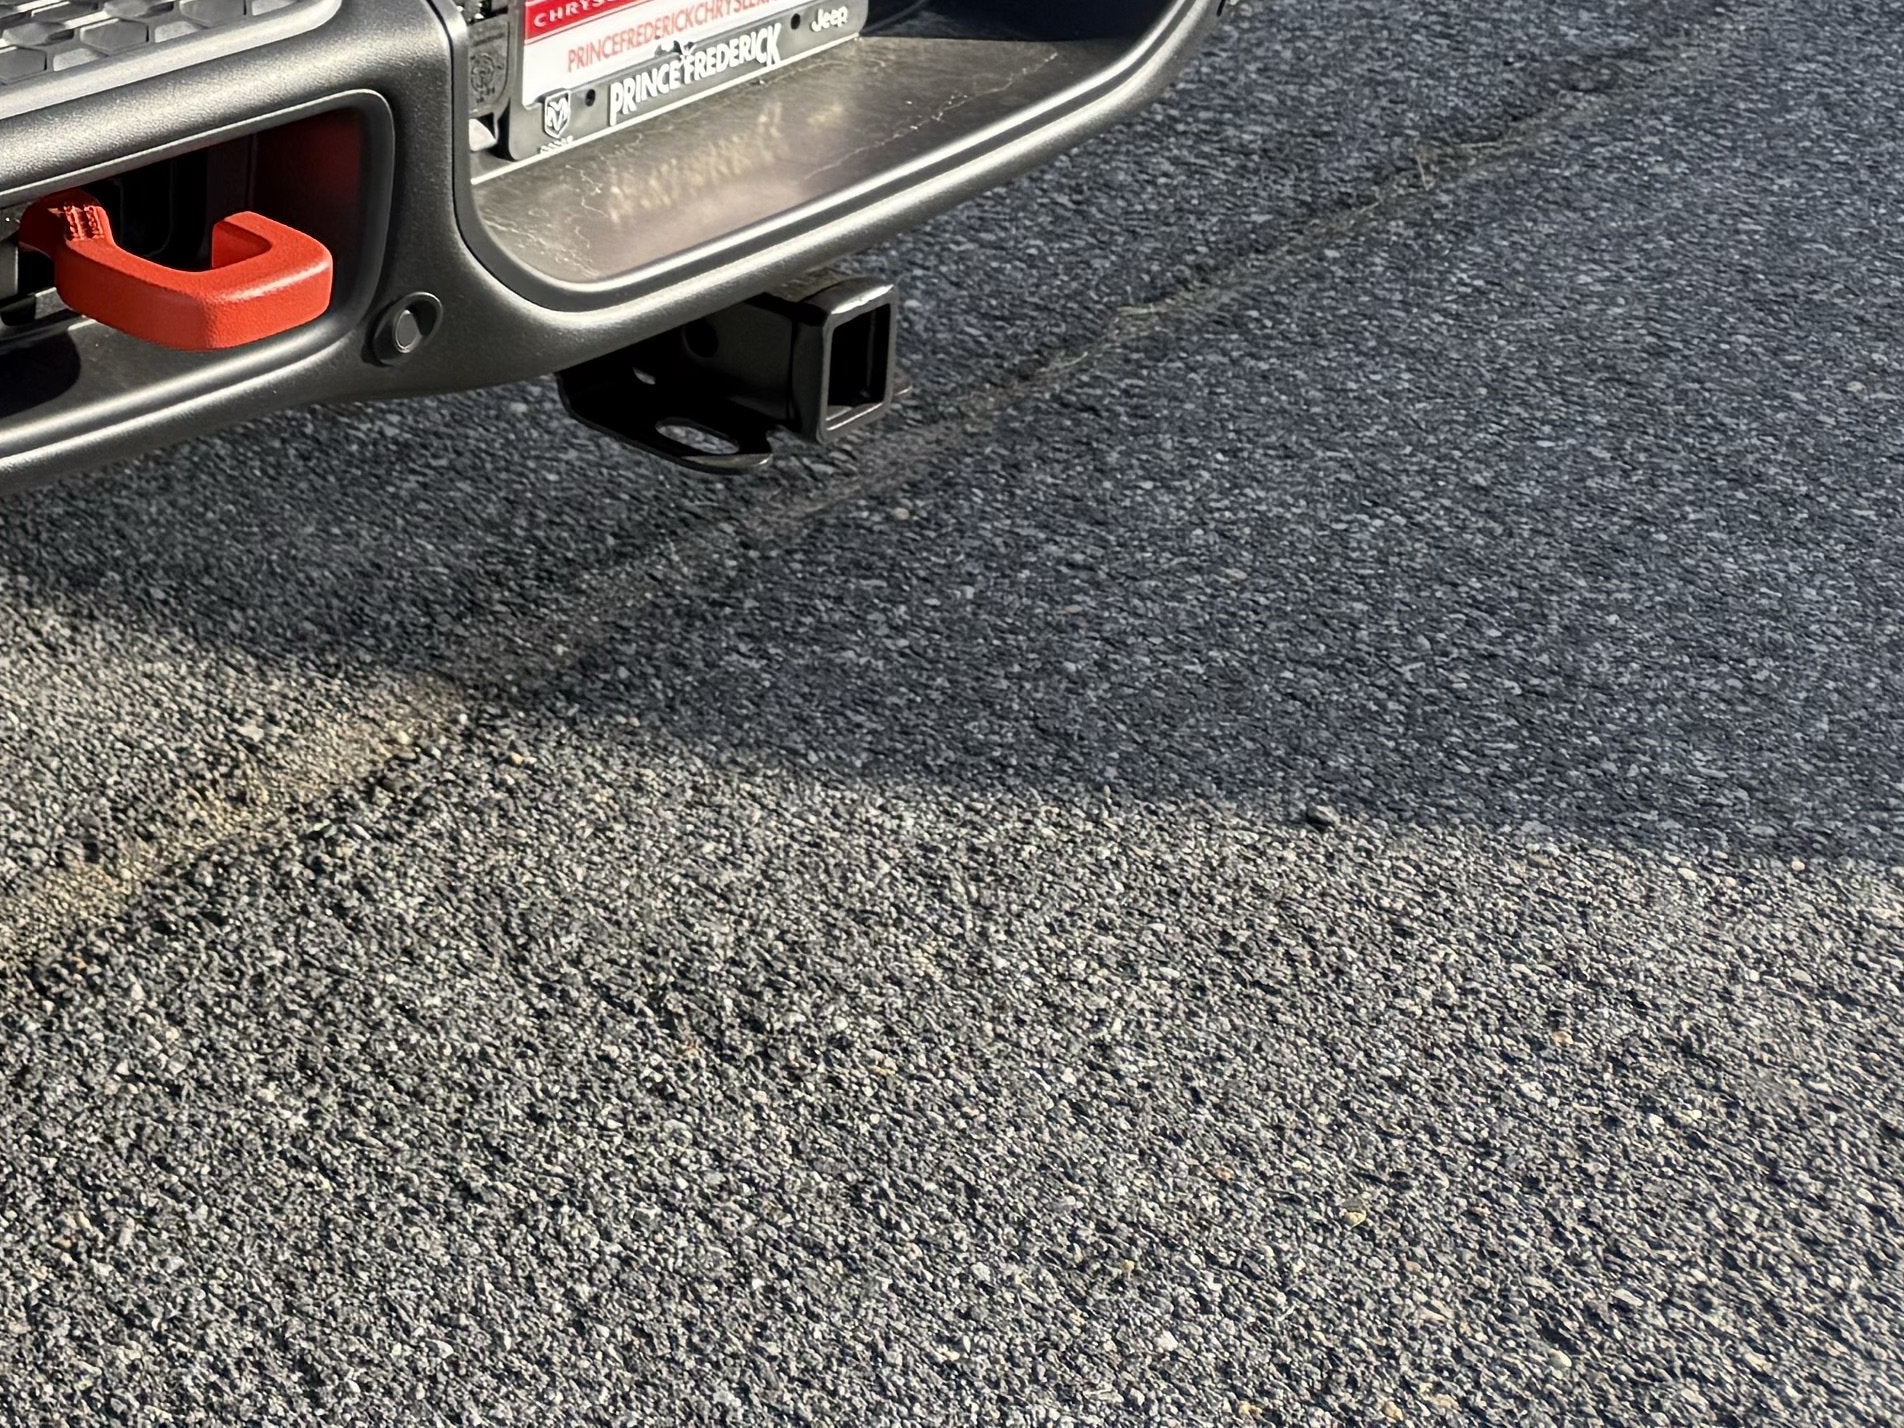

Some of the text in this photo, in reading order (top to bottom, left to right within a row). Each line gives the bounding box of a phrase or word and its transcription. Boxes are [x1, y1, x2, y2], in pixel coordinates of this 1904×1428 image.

[810, 6, 849, 33] Jeep
[609, 22, 782, 127] PRINCE FREDERICK
